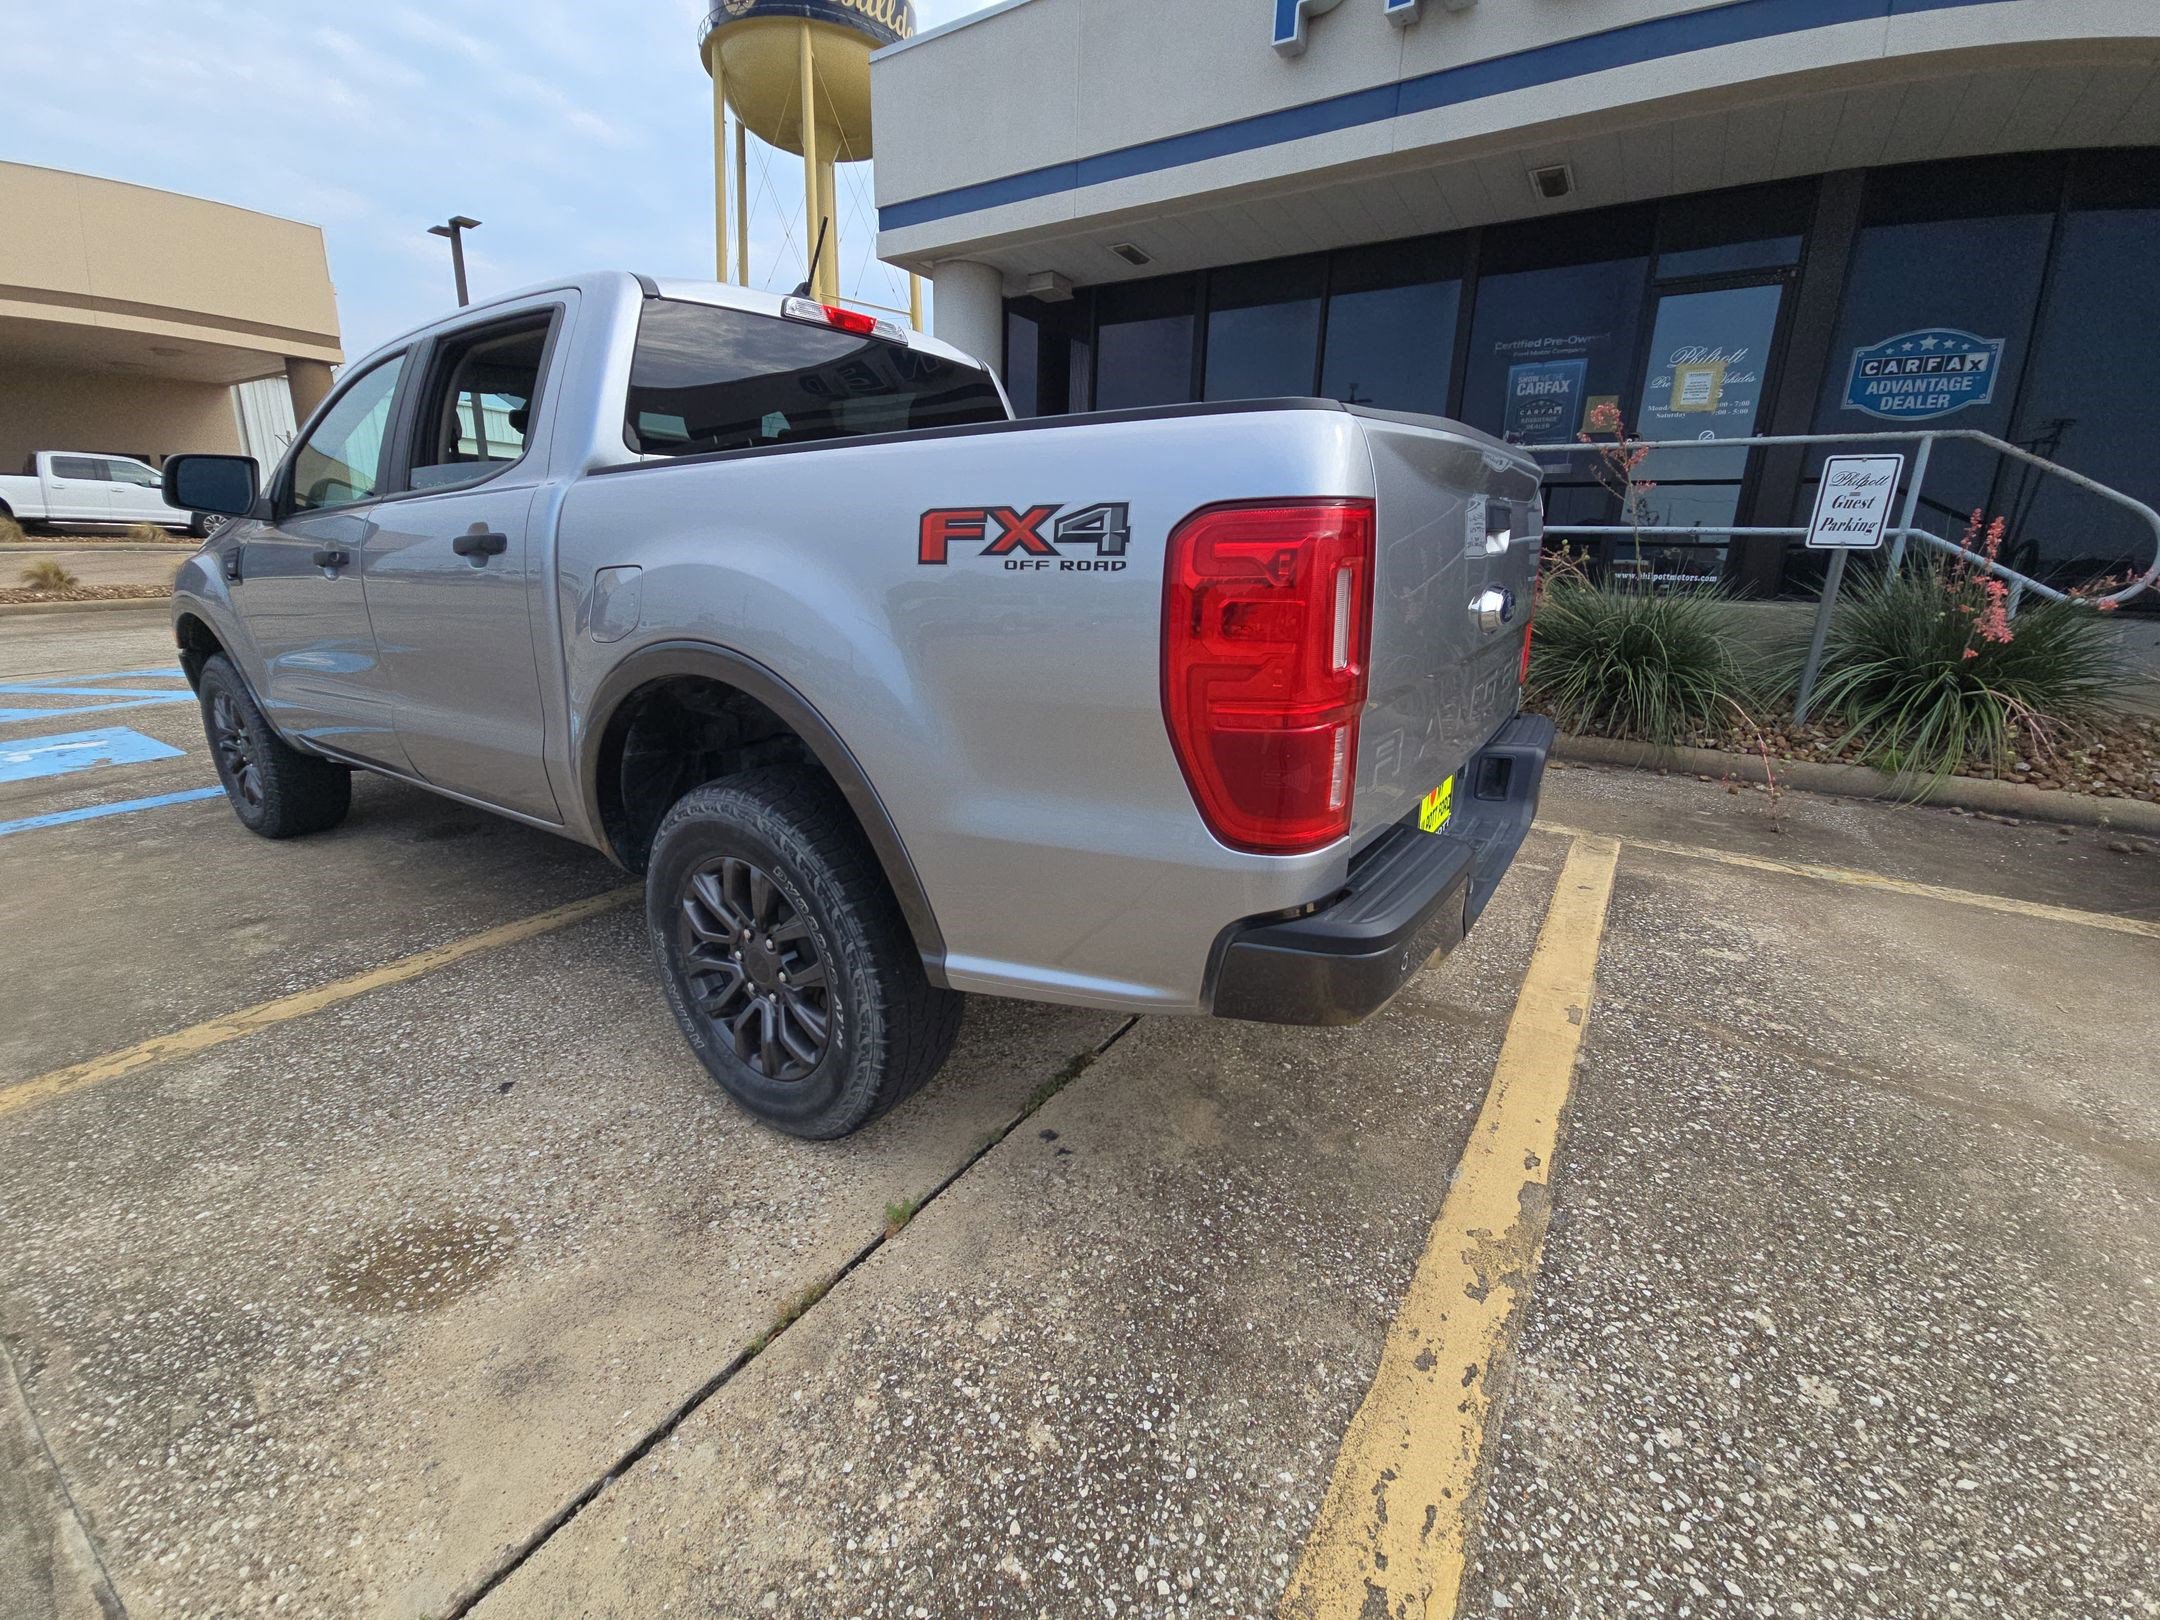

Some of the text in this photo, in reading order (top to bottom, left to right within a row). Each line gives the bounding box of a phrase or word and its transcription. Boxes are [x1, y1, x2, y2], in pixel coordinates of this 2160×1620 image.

[1495, 332, 1610, 350] Certified Pre-Ownd
[1863, 355, 1986, 376] CARFAX
[1516, 380, 1571, 396] CARFAX
[1865, 376, 1974, 395] ADVANTAGE
[1879, 394, 1952, 411] DEALER
[1656, 411, 1686, 419] Saturday
[1828, 470, 1891, 490] Philpott
[1831, 494, 1876, 510] Guest
[918, 502, 1130, 564] FX4
[1819, 517, 1878, 536] Parking
[1004, 560, 1127, 572] OFF ROAD
